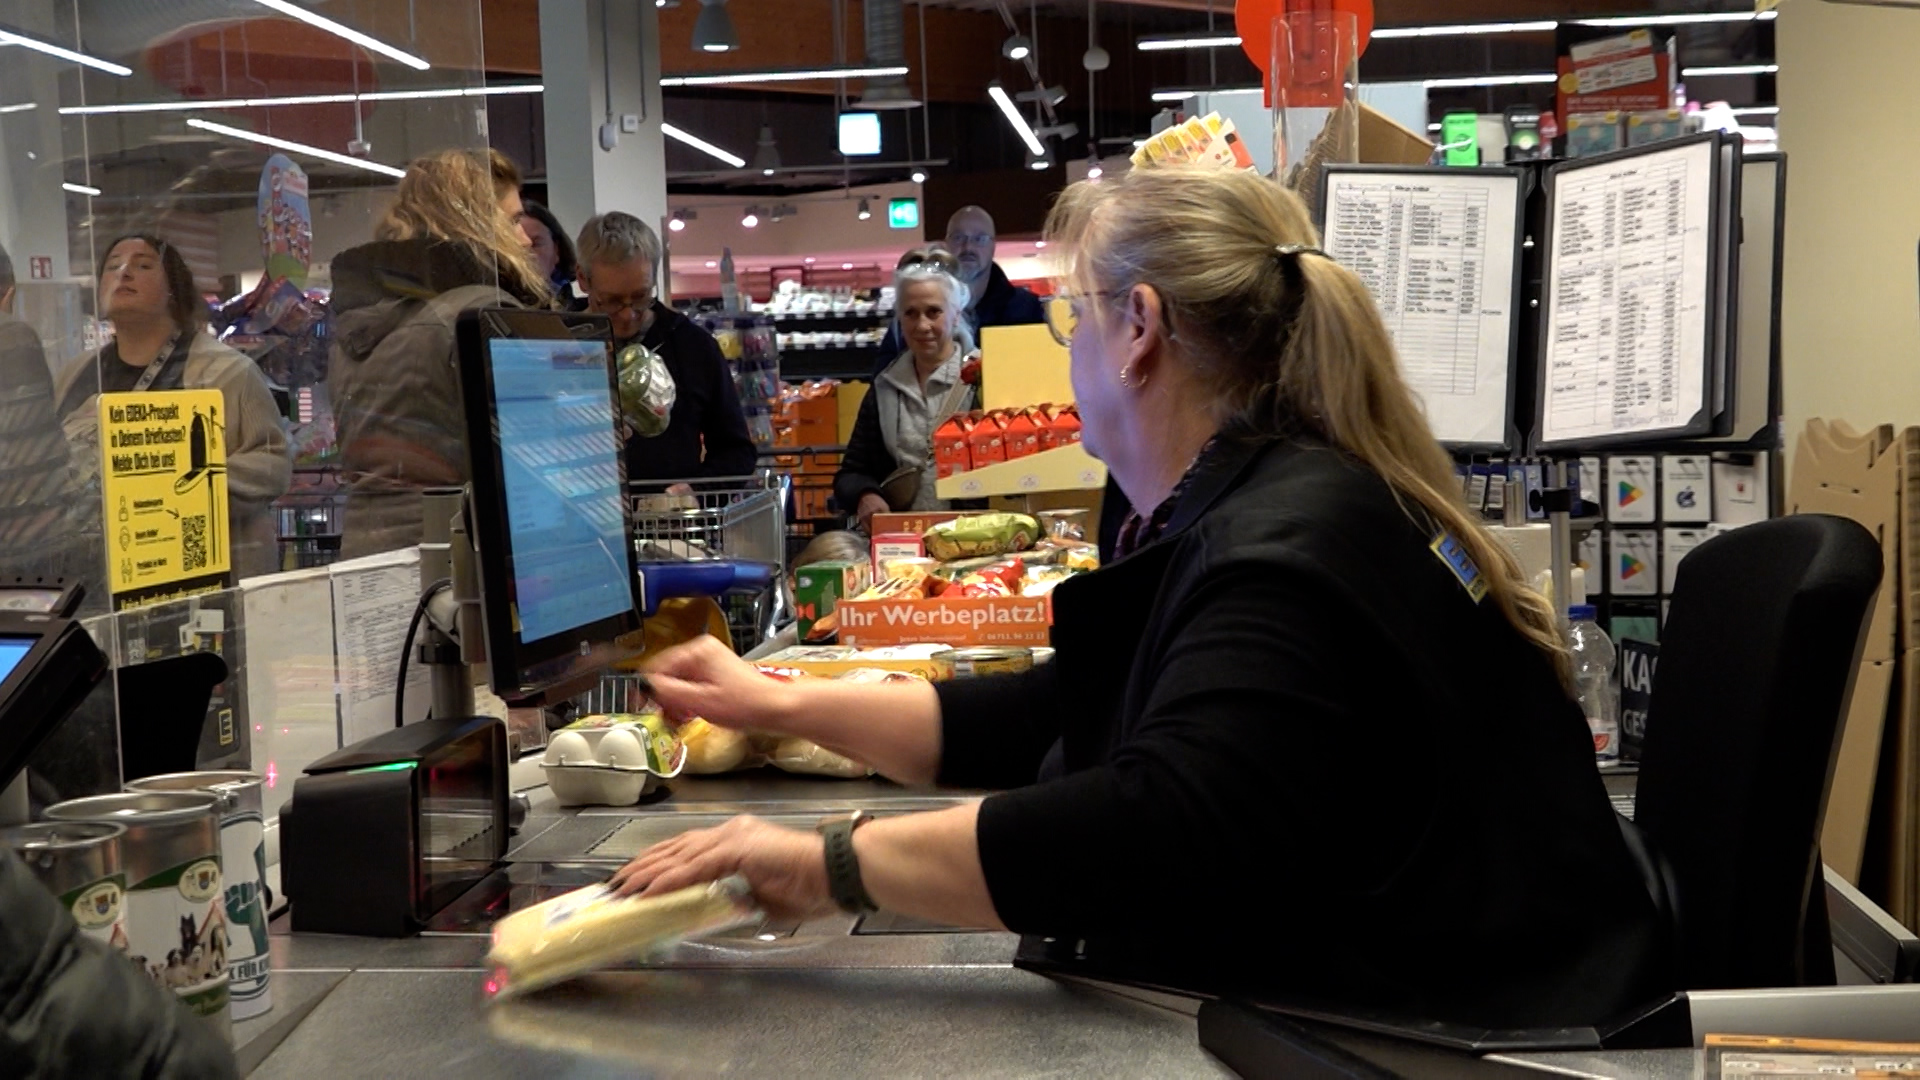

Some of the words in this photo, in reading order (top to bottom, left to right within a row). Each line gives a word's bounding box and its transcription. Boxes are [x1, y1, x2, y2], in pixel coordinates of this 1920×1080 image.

[109, 405, 125, 424] Kein
[111, 430, 118, 448] in
[119, 429, 144, 448] Deinem
[145, 425, 186, 446] Briefkasten?
[112, 454, 133, 472] Melde
[134, 452, 149, 470] Dich
[150, 450, 160, 468] bei
[161, 449, 176, 468] uns!
[841, 606, 878, 627] Ihr
[881, 600, 1046, 630] Werbeplatz!
[238, 960, 257, 979] FÜR
